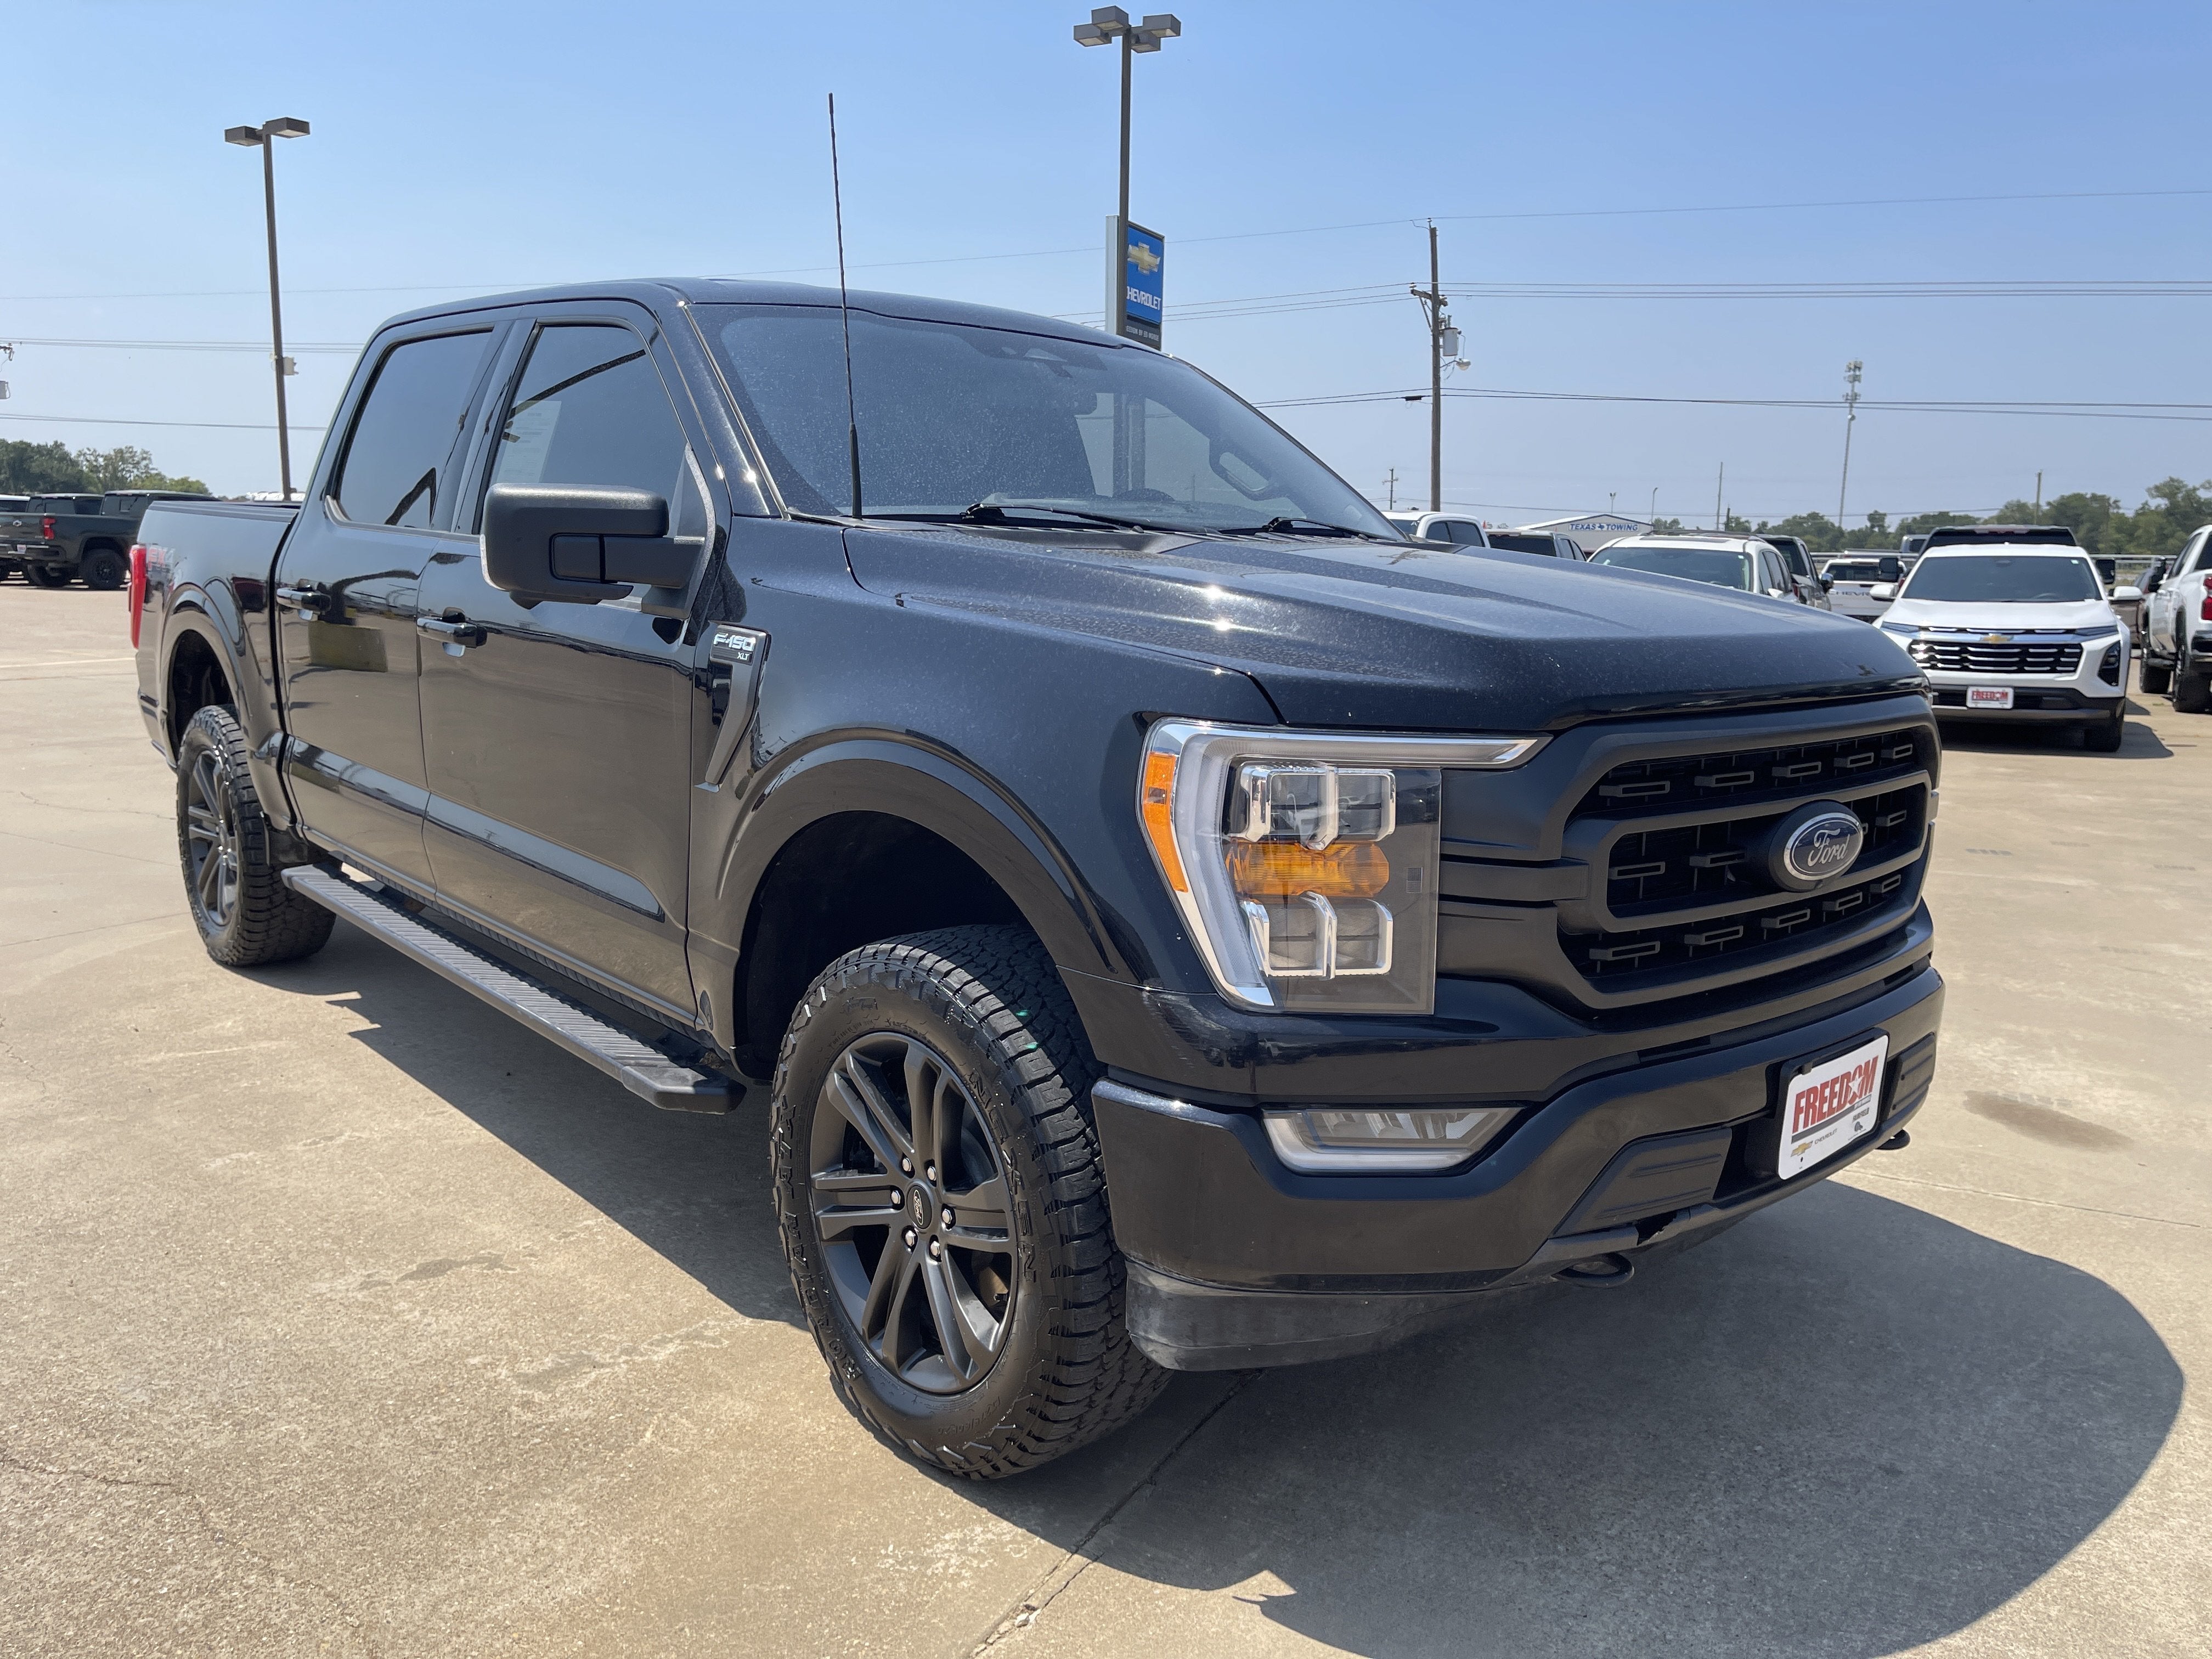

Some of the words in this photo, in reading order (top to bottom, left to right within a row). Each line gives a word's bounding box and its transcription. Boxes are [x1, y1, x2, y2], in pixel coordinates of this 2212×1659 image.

[714, 632, 756, 652] F-150
[737, 652, 750, 660] XLT
[1807, 828, 1850, 867] Ford
[1793, 1055, 1879, 1135] FREEDOM
[914, 1196, 922, 1219] Ford
